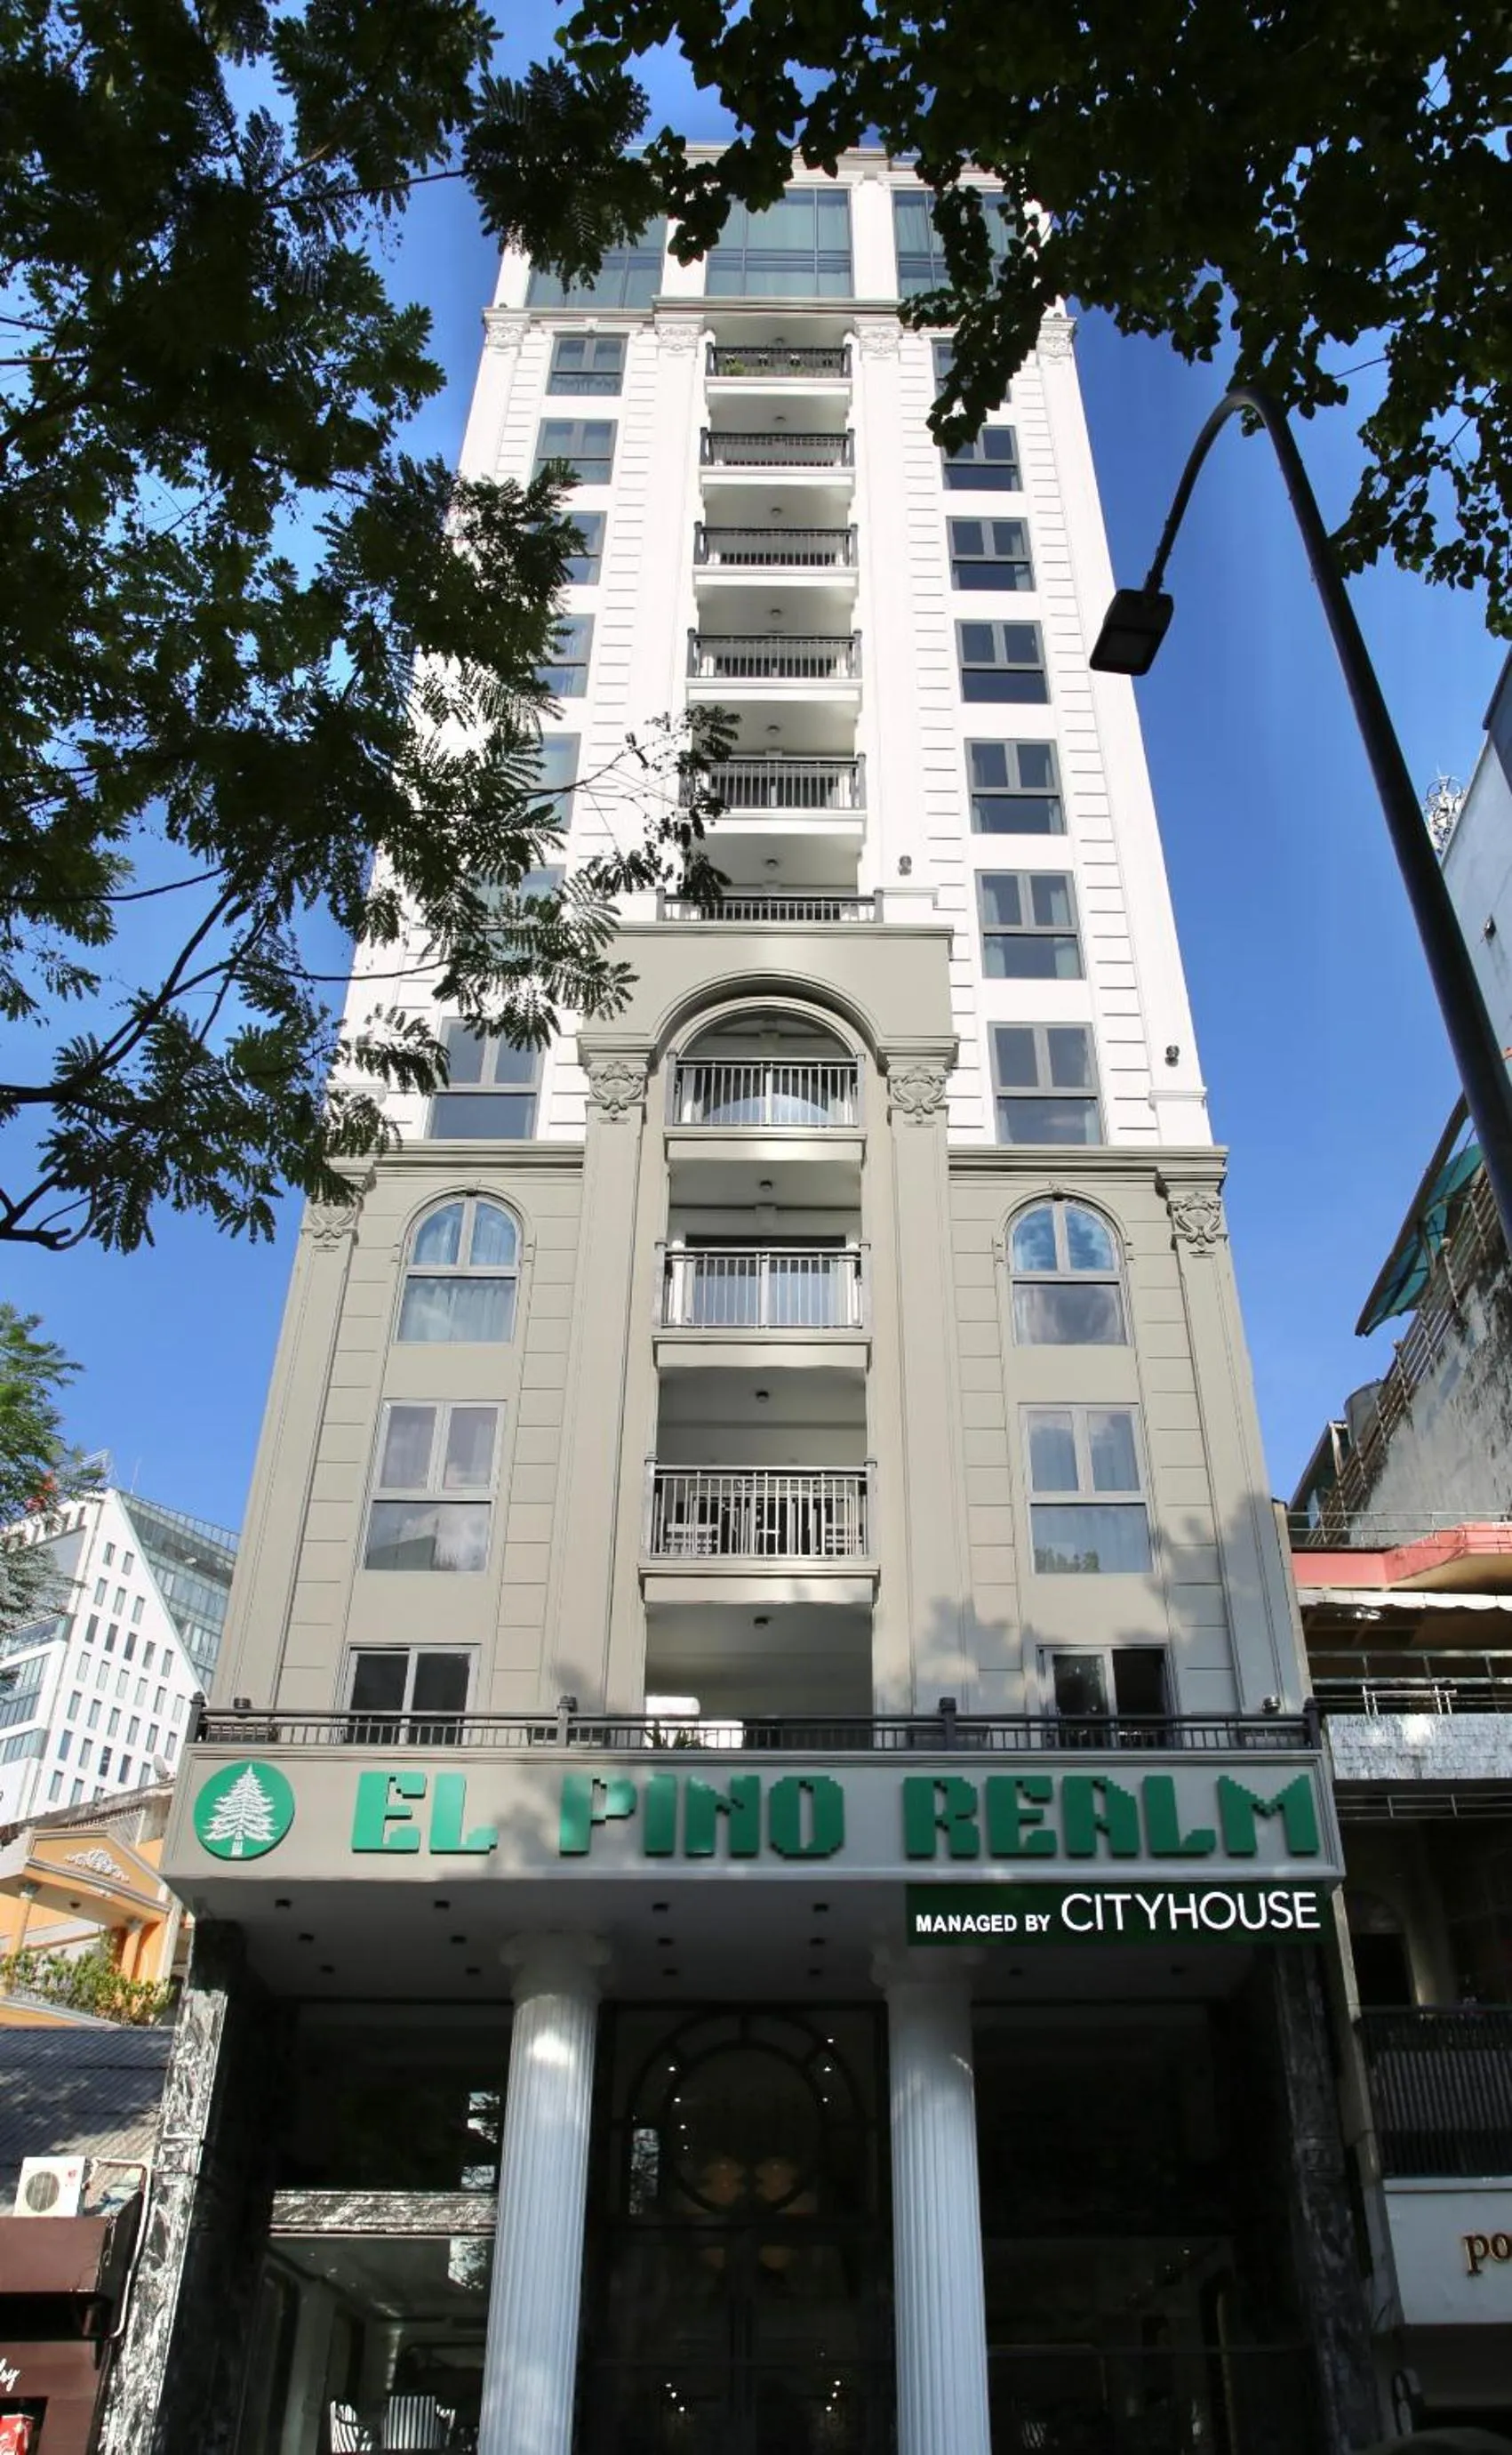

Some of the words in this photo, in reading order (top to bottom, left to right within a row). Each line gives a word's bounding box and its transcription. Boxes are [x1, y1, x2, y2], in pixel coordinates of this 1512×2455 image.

[351, 1770, 500, 1855] EL
[559, 1774, 845, 1860] PINO
[903, 1774, 1320, 1859] REALM
[916, 1913, 1018, 1932] MANAGED
[1025, 1913, 1052, 1932] BY
[1060, 1890, 1322, 1931] CITYHOUSE
